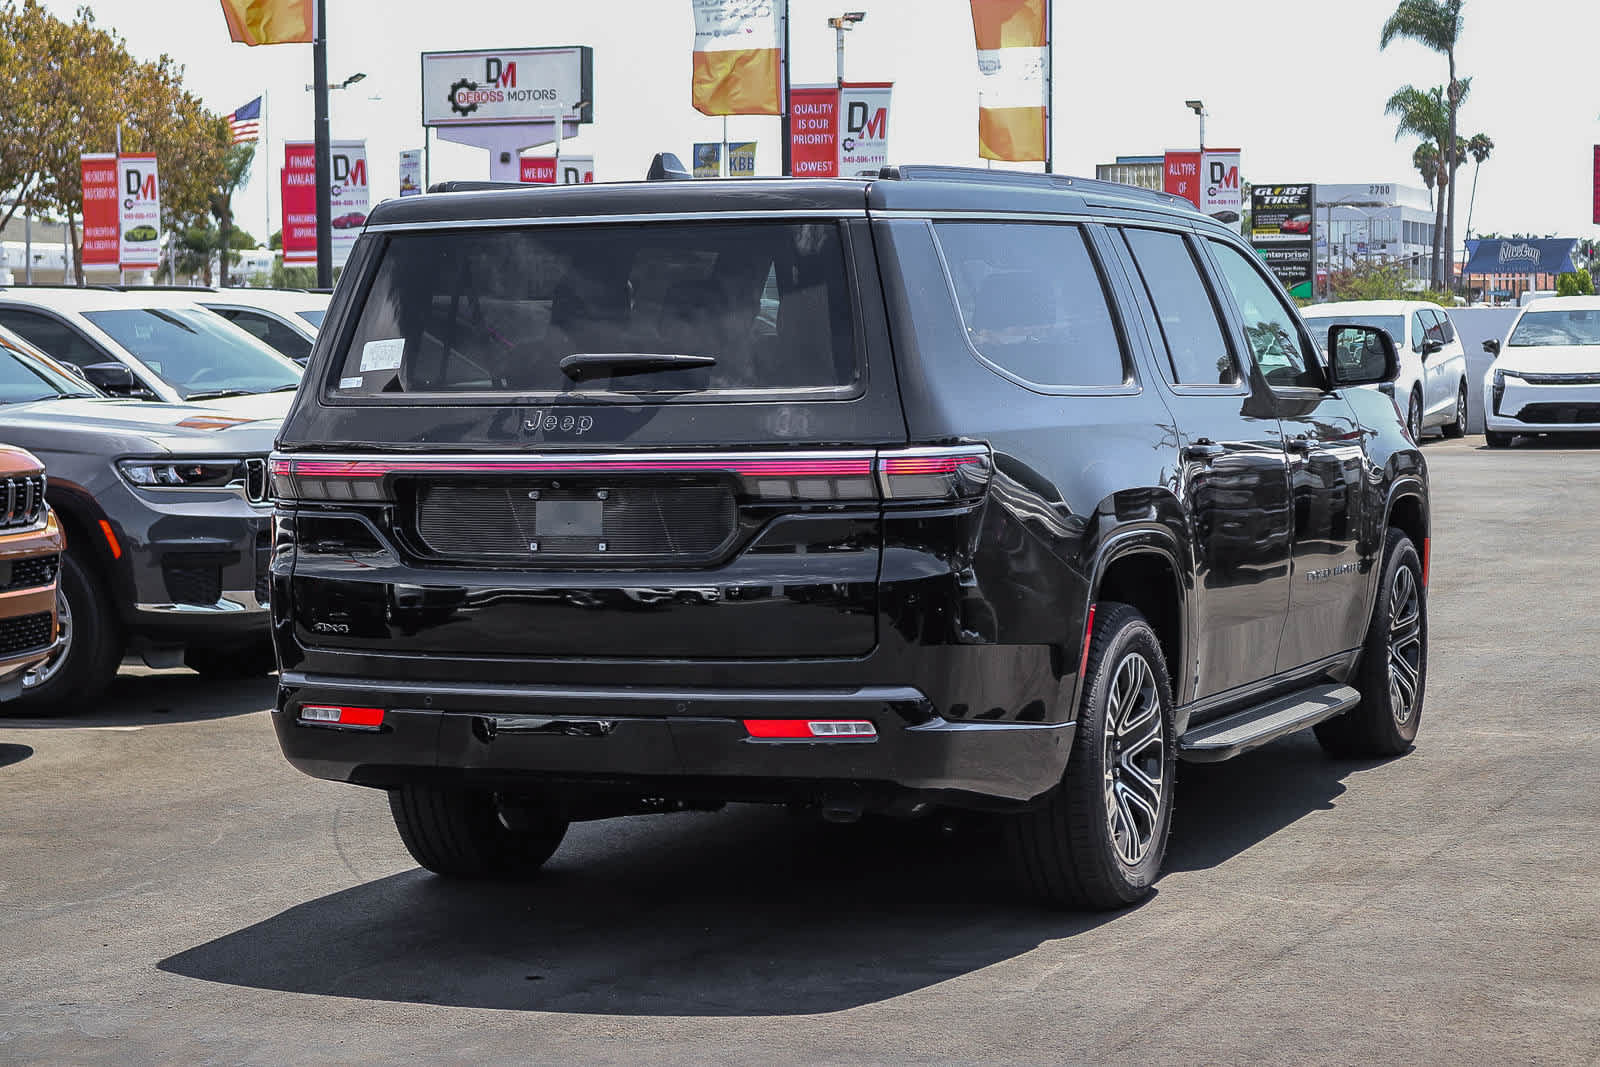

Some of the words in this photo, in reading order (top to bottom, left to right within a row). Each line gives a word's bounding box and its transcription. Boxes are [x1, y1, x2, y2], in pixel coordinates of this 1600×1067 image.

[486, 57, 517, 88] DM
[457, 91, 504, 104] DEBOSS
[507, 89, 557, 102] MOTORS
[794, 103, 833, 115] QUALITY
[798, 119, 807, 129] IS
[808, 119, 829, 129] OUR
[847, 101, 887, 140] DM
[793, 134, 834, 145] PRIORITY
[332, 153, 367, 187] DM
[729, 156, 754, 171] KBB
[796, 161, 833, 172] LOWEST
[1169, 162, 1181, 176] ALL
[1181, 162, 1196, 176] TYPE
[524, 167, 537, 179] WE
[537, 167, 554, 179] BUY
[1210, 161, 1239, 190] DM
[126, 169, 157, 201] DM
[1178, 182, 1187, 194] OF
[1263, 195, 1300, 205] TIRE
[524, 410, 593, 435] Jeep
